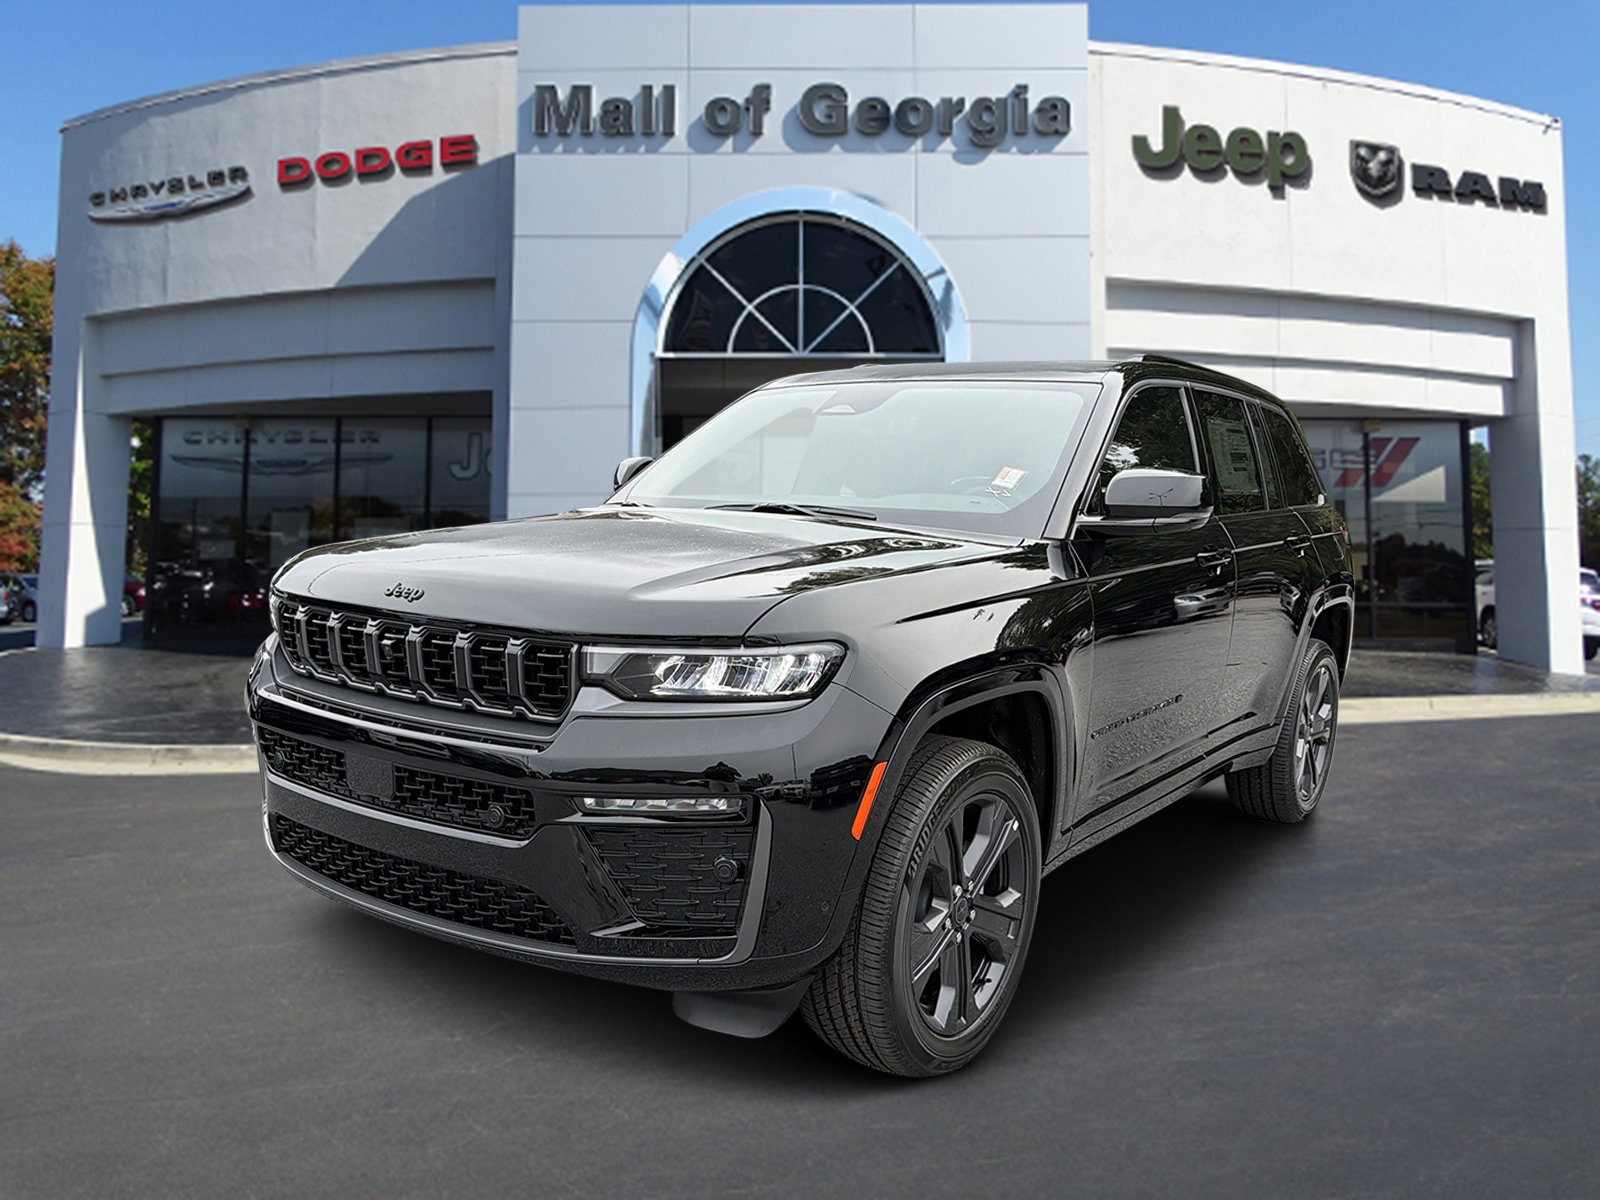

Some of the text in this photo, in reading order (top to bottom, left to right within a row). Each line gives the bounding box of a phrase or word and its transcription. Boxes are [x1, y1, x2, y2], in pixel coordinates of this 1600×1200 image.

[533, 83, 1072, 149] Mall of Georgia
[277, 134, 477, 188] DODGE
[1132, 105, 1311, 190] Jeep
[89, 165, 249, 207] CHRYSLER
[1411, 163, 1548, 214] RAM
[183, 429, 381, 445] CHRYSLER
[384, 582, 425, 603] Jeep
